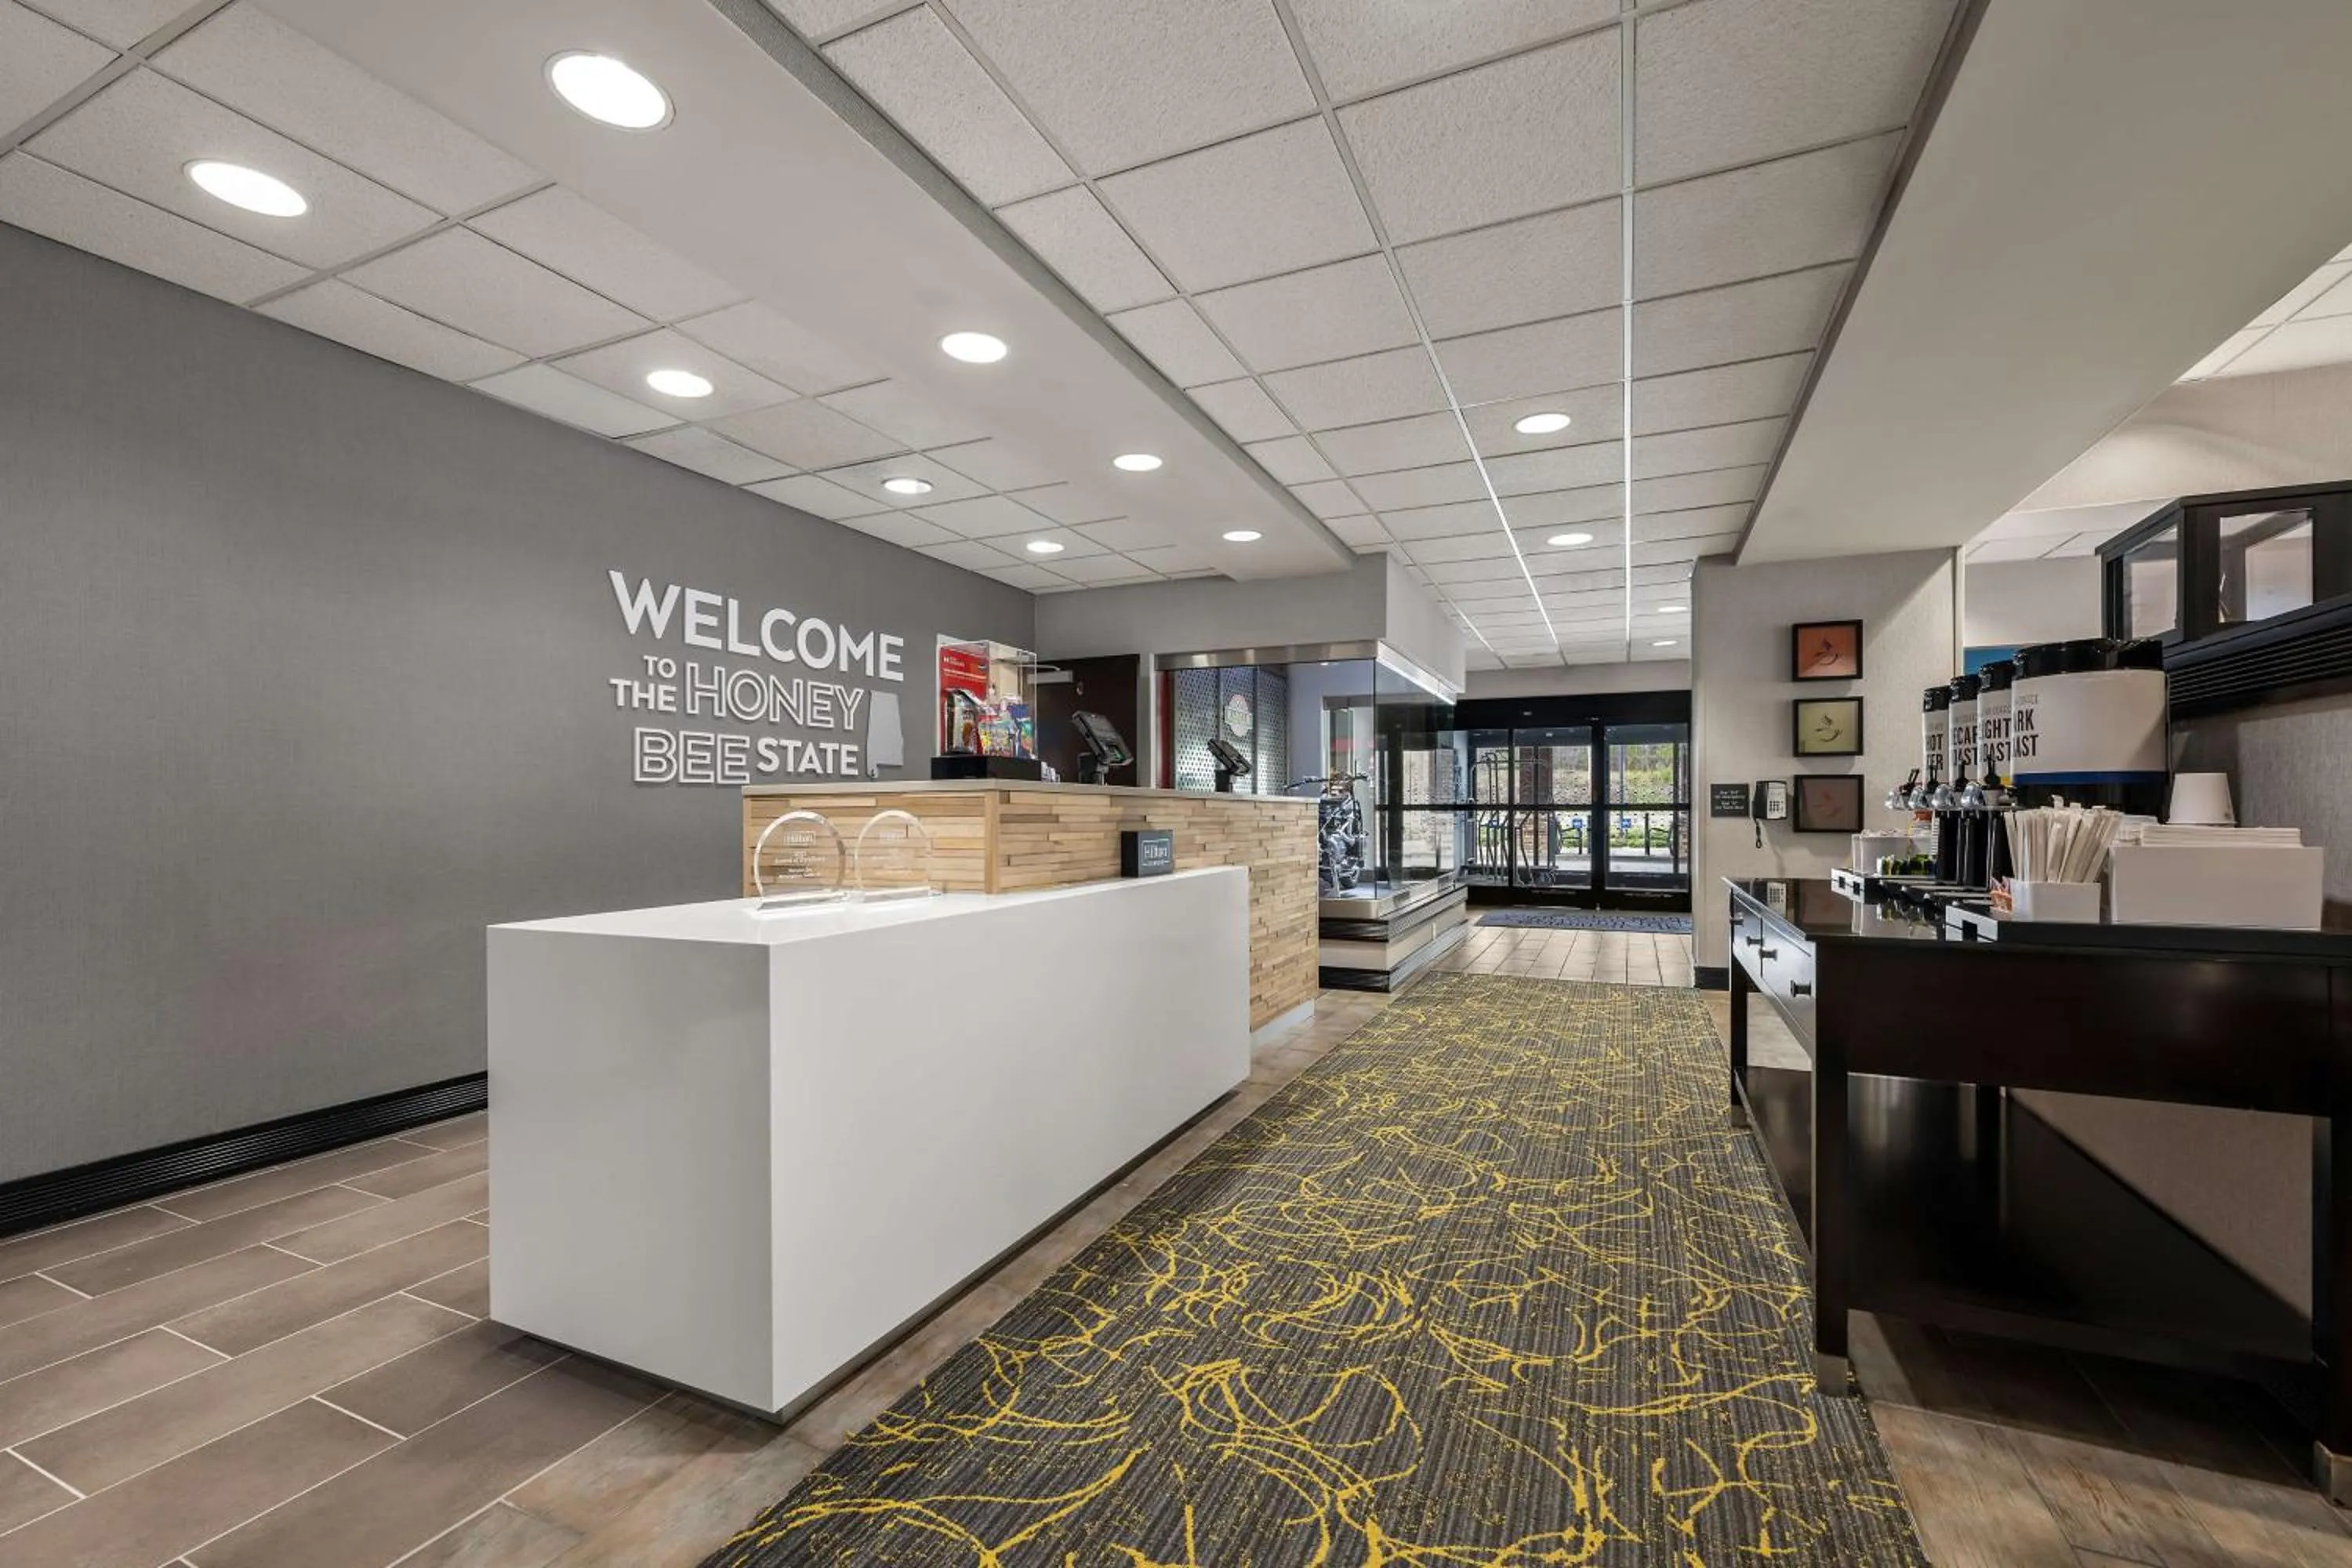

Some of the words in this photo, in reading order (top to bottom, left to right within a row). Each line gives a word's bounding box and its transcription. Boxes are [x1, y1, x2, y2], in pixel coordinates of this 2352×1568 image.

[608, 570, 904, 681] WELCOME
[609, 678, 677, 713] THE
[685, 662, 864, 730] HONEY
[643, 655, 677, 678] TO
[633, 727, 750, 784] BEE
[757, 737, 859, 776] STATE
